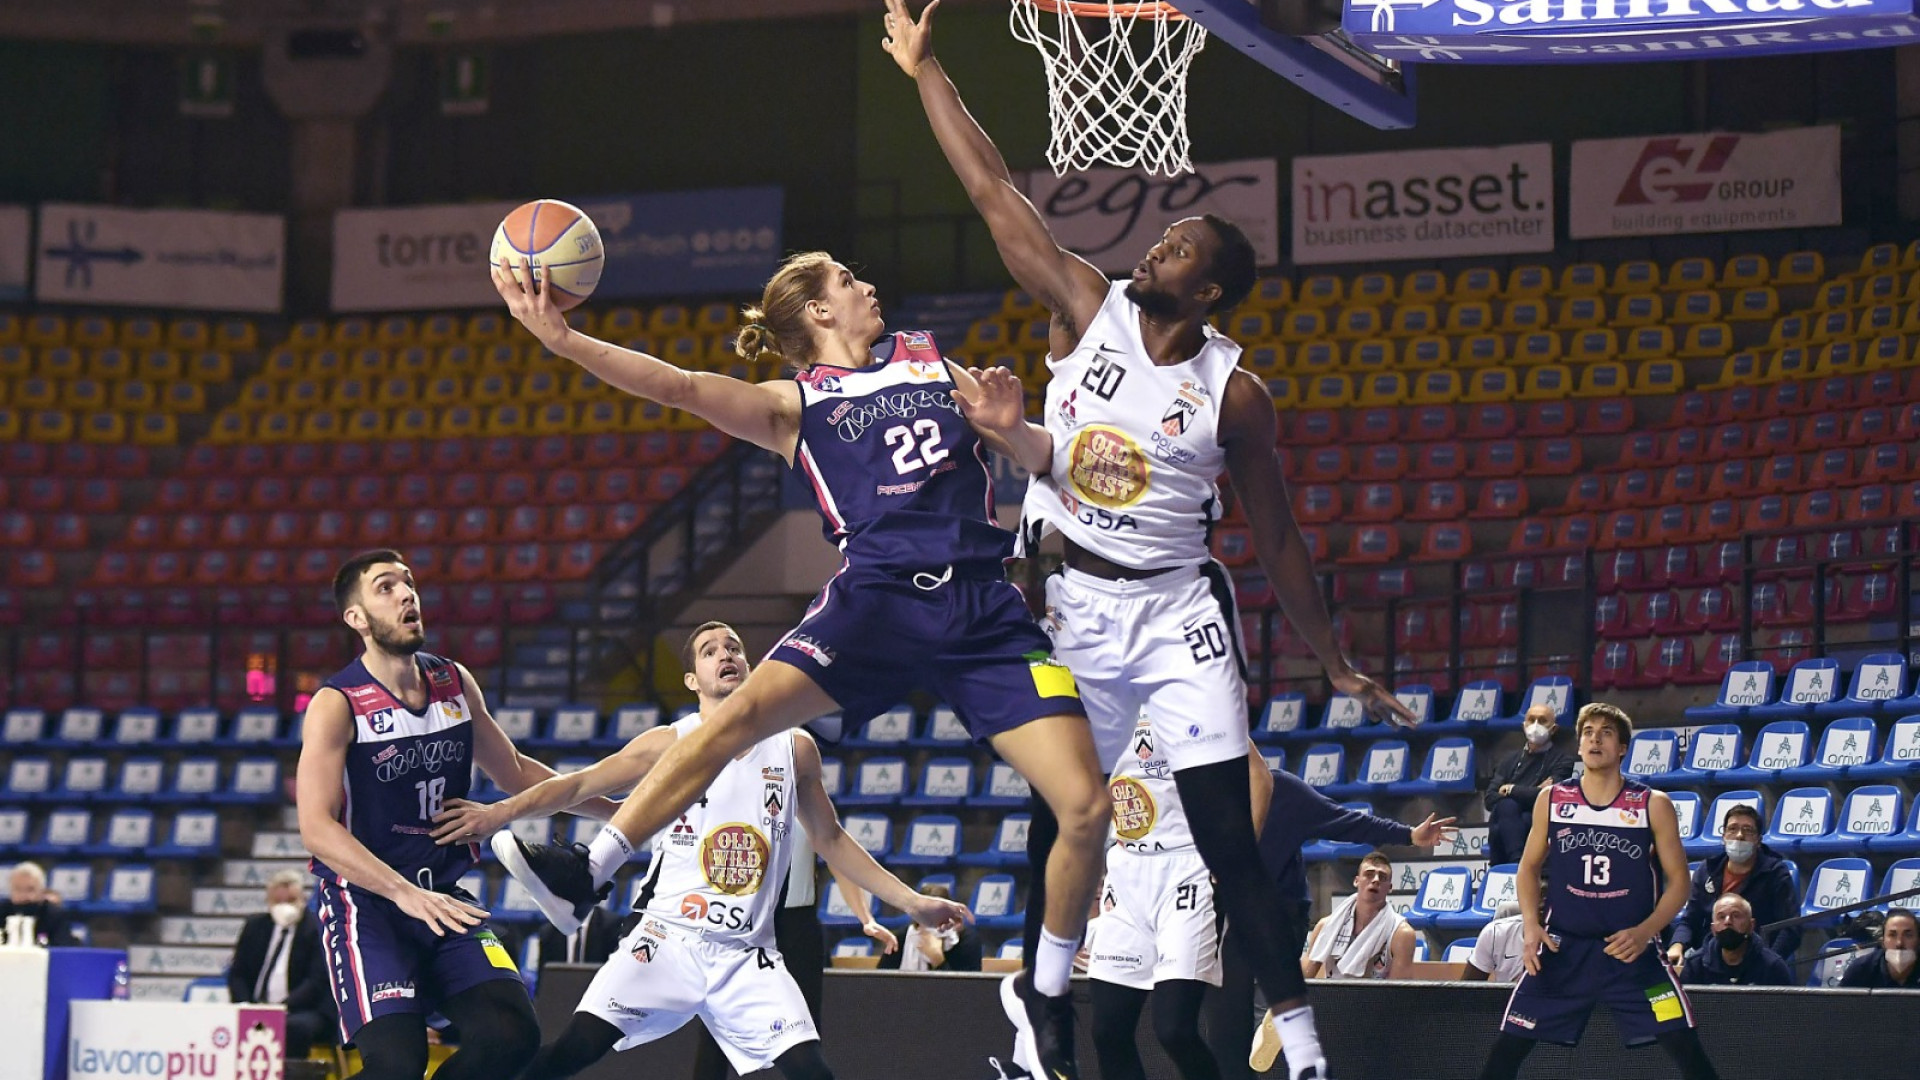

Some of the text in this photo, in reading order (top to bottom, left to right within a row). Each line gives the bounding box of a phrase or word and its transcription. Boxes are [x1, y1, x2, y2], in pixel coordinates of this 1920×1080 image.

[1548, 25, 1916, 54] saniRad
[1303, 162, 1546, 223] inasset.
[1717, 178, 1795, 200] GROUP
[1304, 216, 1545, 247] business datacenter
[1611, 206, 1797, 231] building equipments
[1080, 353, 1127, 403] 20
[1173, 398, 1197, 416] APU
[883, 418, 950, 476] 22
[1091, 433, 1133, 466] OLD
[1073, 463, 1135, 502] WEST
[1077, 507, 1139, 532] GSA
[1183, 621, 1227, 665] 20
[414, 776, 446, 821] 18
[765, 782, 783, 793] APU
[1784, 820, 1820, 833] arriva
[1852, 819, 1890, 832] arriva
[717, 831, 757, 850] OLD
[712, 849, 762, 868] WILD
[1580, 854, 1611, 886] 13
[709, 866, 763, 886] WEST
[1175, 884, 1198, 911] 21
[706, 901, 754, 932] GSA
[372, 980, 416, 992] ITALIA
